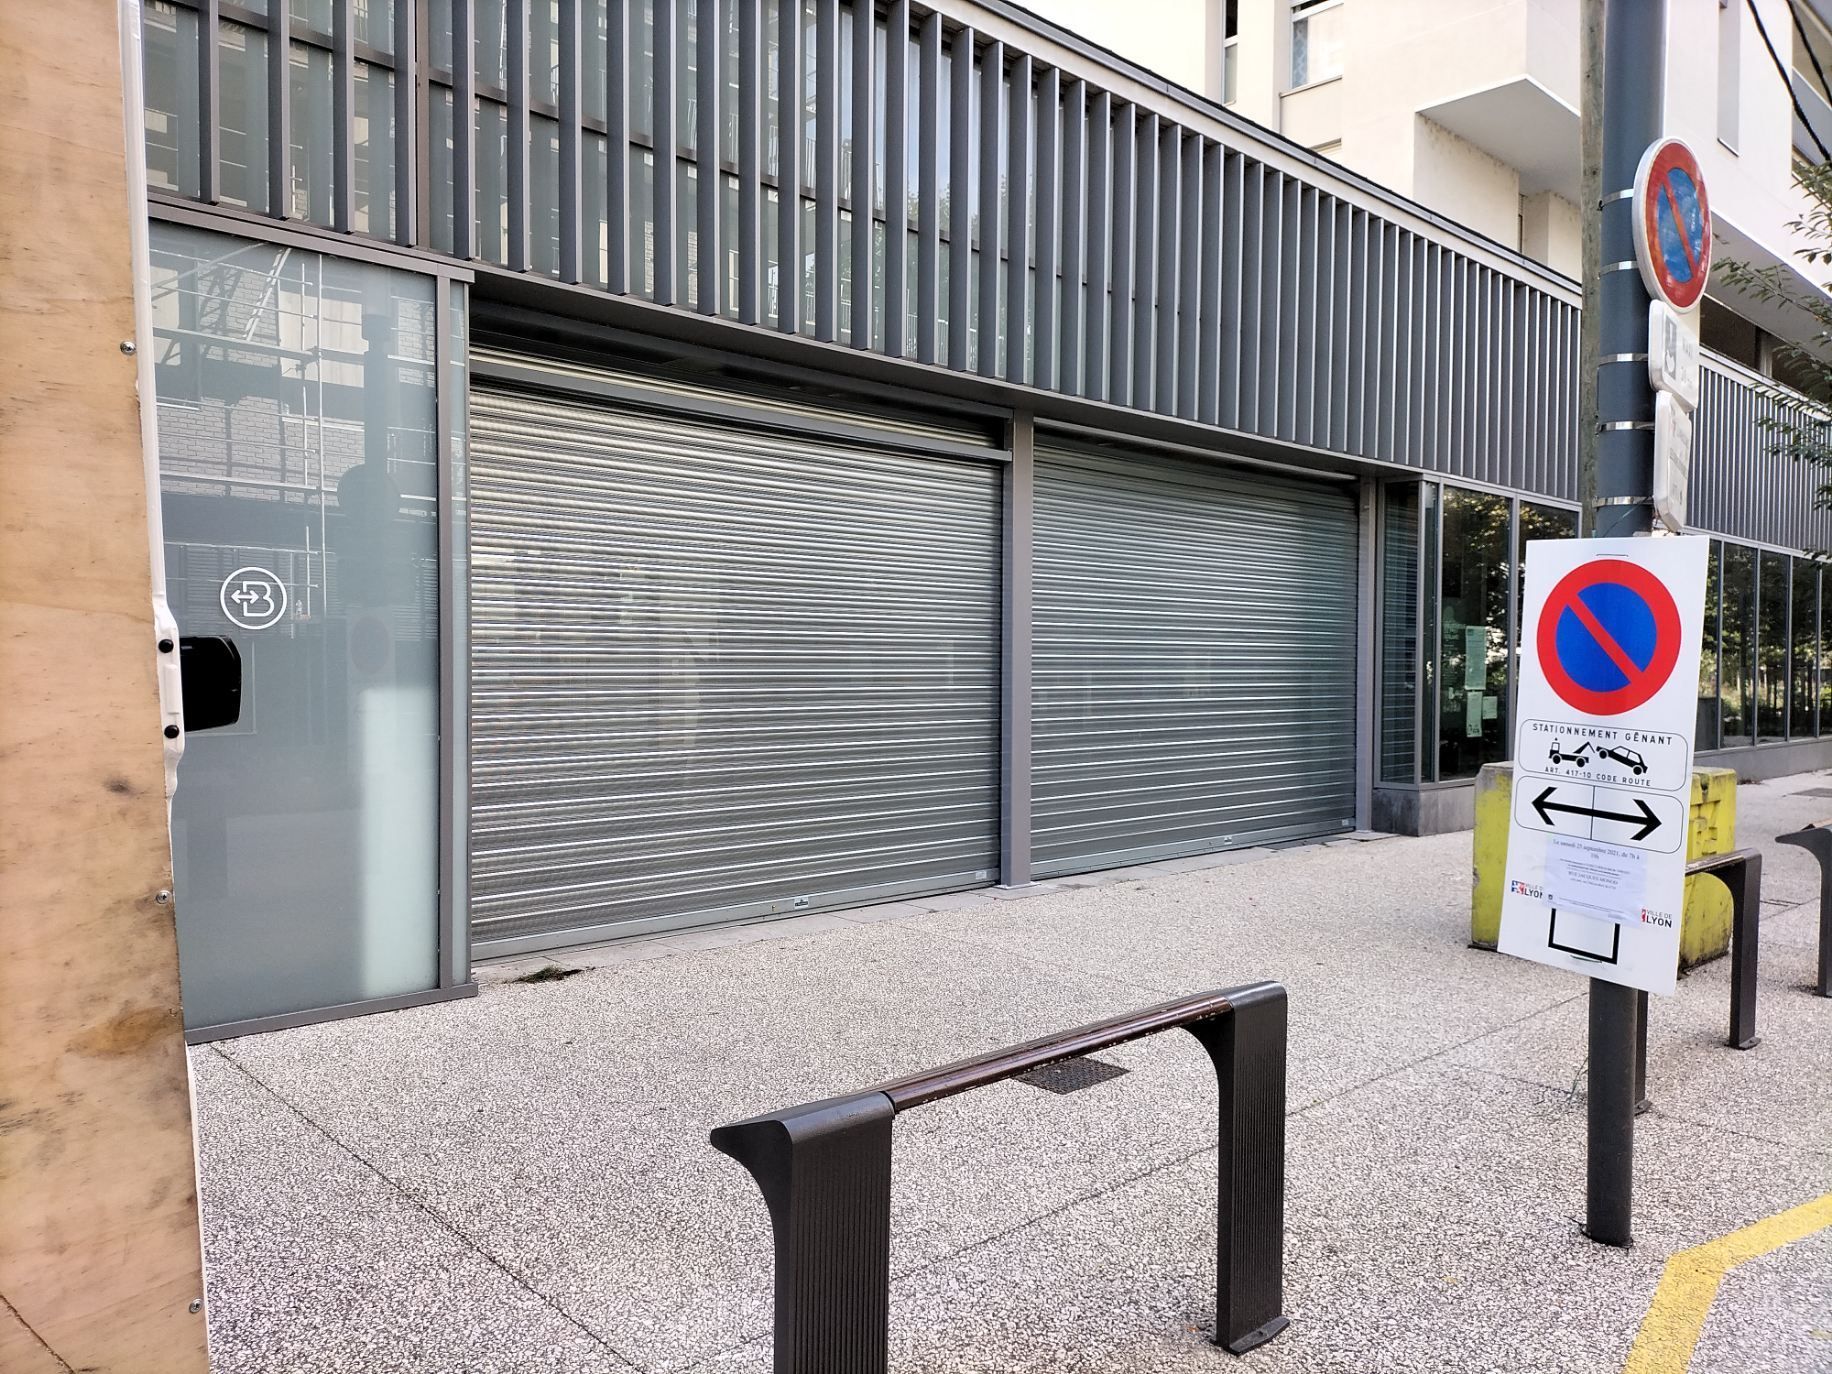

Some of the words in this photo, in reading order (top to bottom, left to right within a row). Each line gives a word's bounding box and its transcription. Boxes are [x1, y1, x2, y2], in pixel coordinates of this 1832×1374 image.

[1532, 723, 1618, 740] STATIONNEMENT
[1625, 732, 1673, 746] GÊNANT
[1544, 767, 1561, 775] ART.
[1566, 769, 1592, 779] 417-10
[1596, 774, 1617, 783] CODE
[1622, 777, 1652, 787] ROUTE
[1646, 914, 1673, 928] LYON
[1647, 910, 1663, 918] VILLE
[1664, 912, 1672, 920] DE
